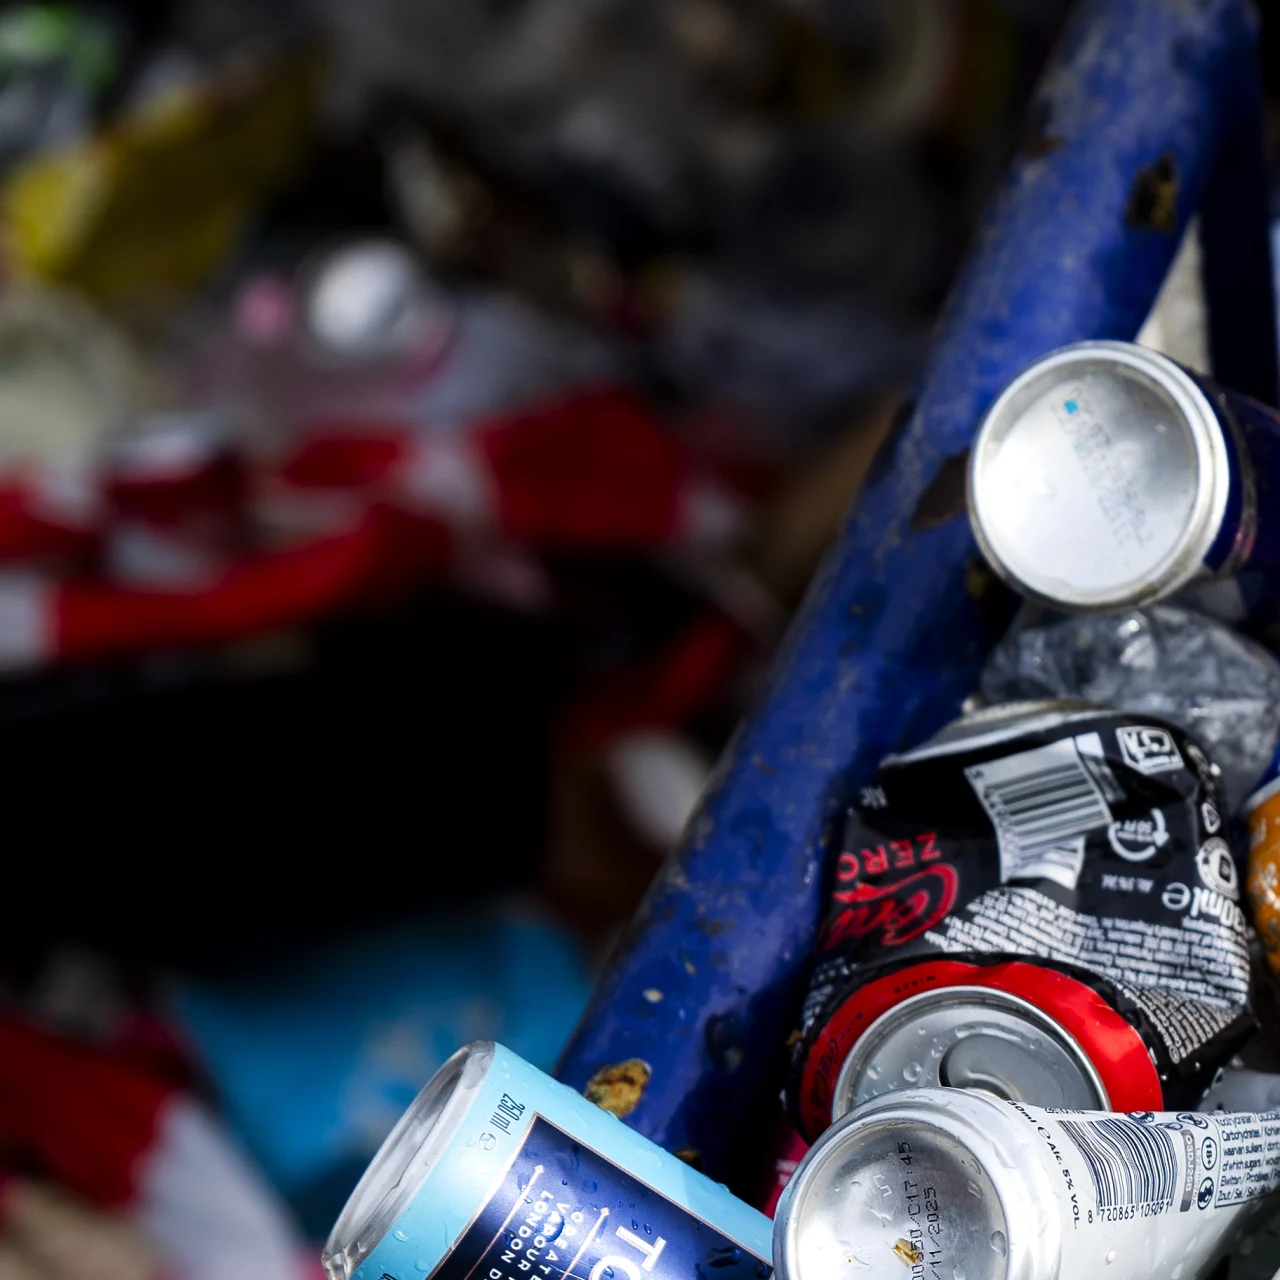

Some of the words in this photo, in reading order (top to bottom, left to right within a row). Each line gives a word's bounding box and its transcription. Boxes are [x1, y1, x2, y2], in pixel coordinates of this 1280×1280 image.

[486, 1109, 515, 1135] ml
[493, 1091, 526, 1121] 250
[495, 1189, 558, 1264] LONDON
[512, 1199, 574, 1273] VAPOUR
